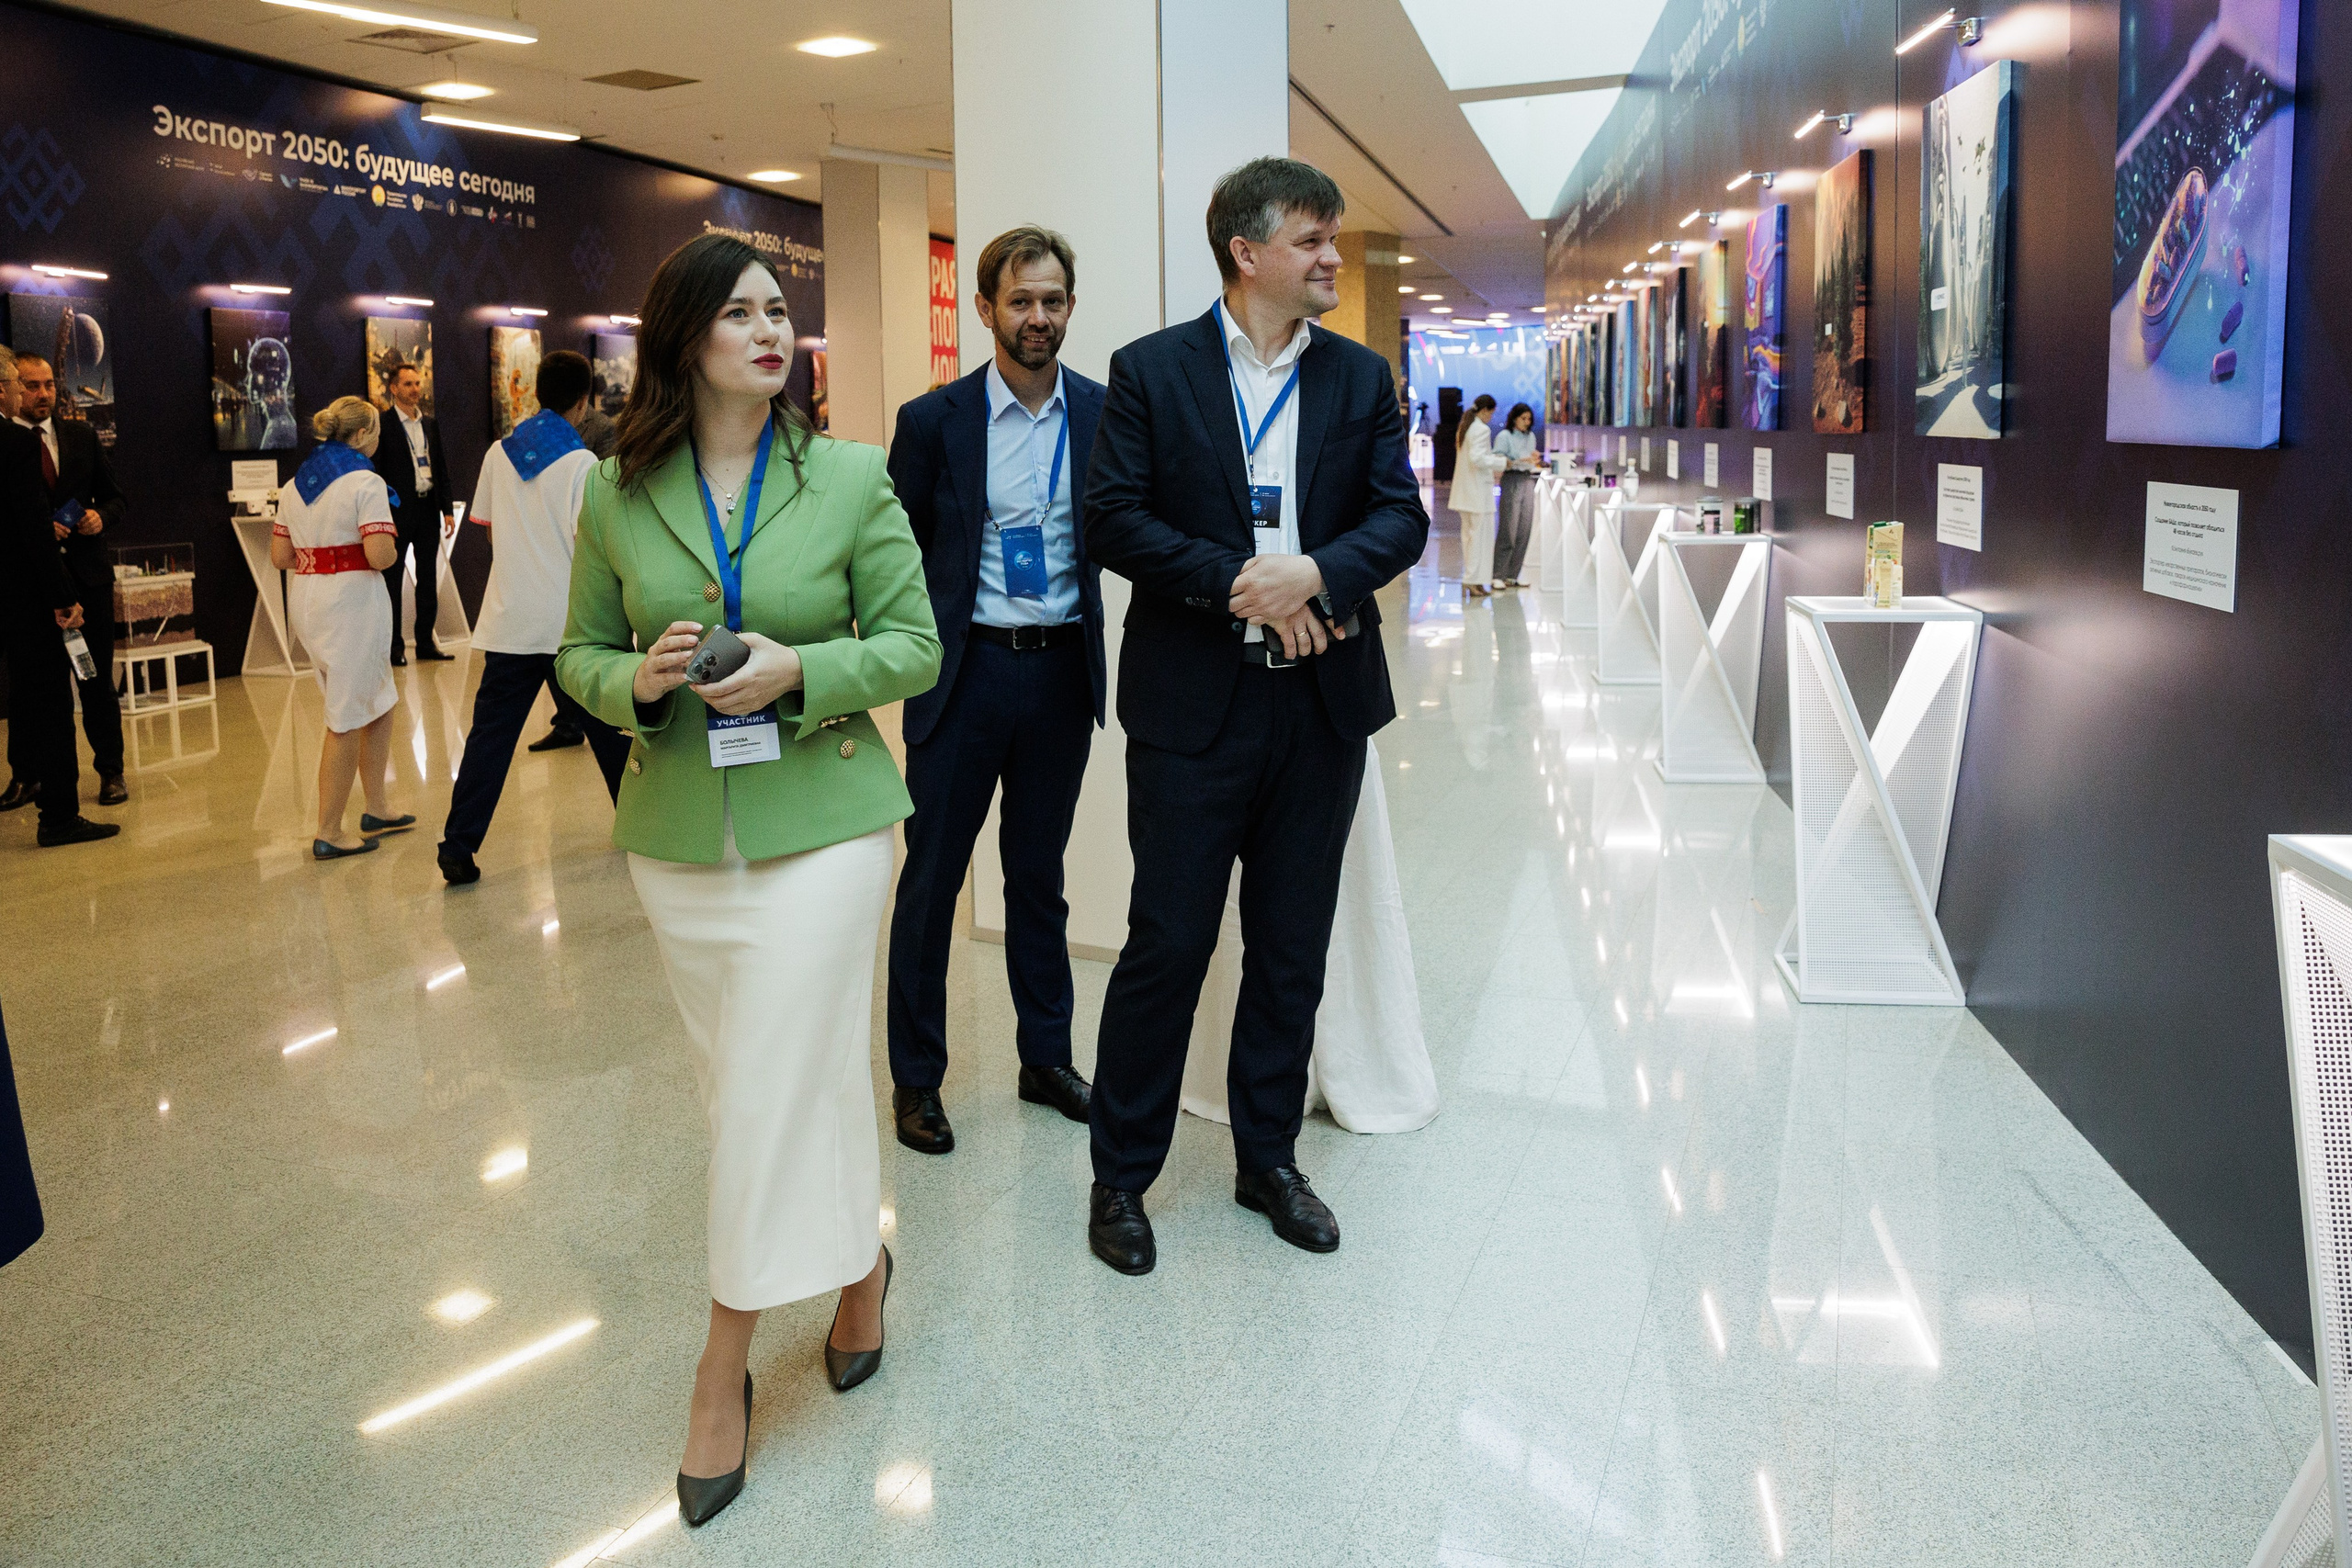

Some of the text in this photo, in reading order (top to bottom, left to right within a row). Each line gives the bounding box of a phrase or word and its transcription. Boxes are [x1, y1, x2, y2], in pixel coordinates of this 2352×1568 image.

[153, 105, 536, 205] Экспорт 2050: будущее сегодня
[753, 231, 782, 254] 2050:
[717, 716, 765, 727] УЧАСТНИК
